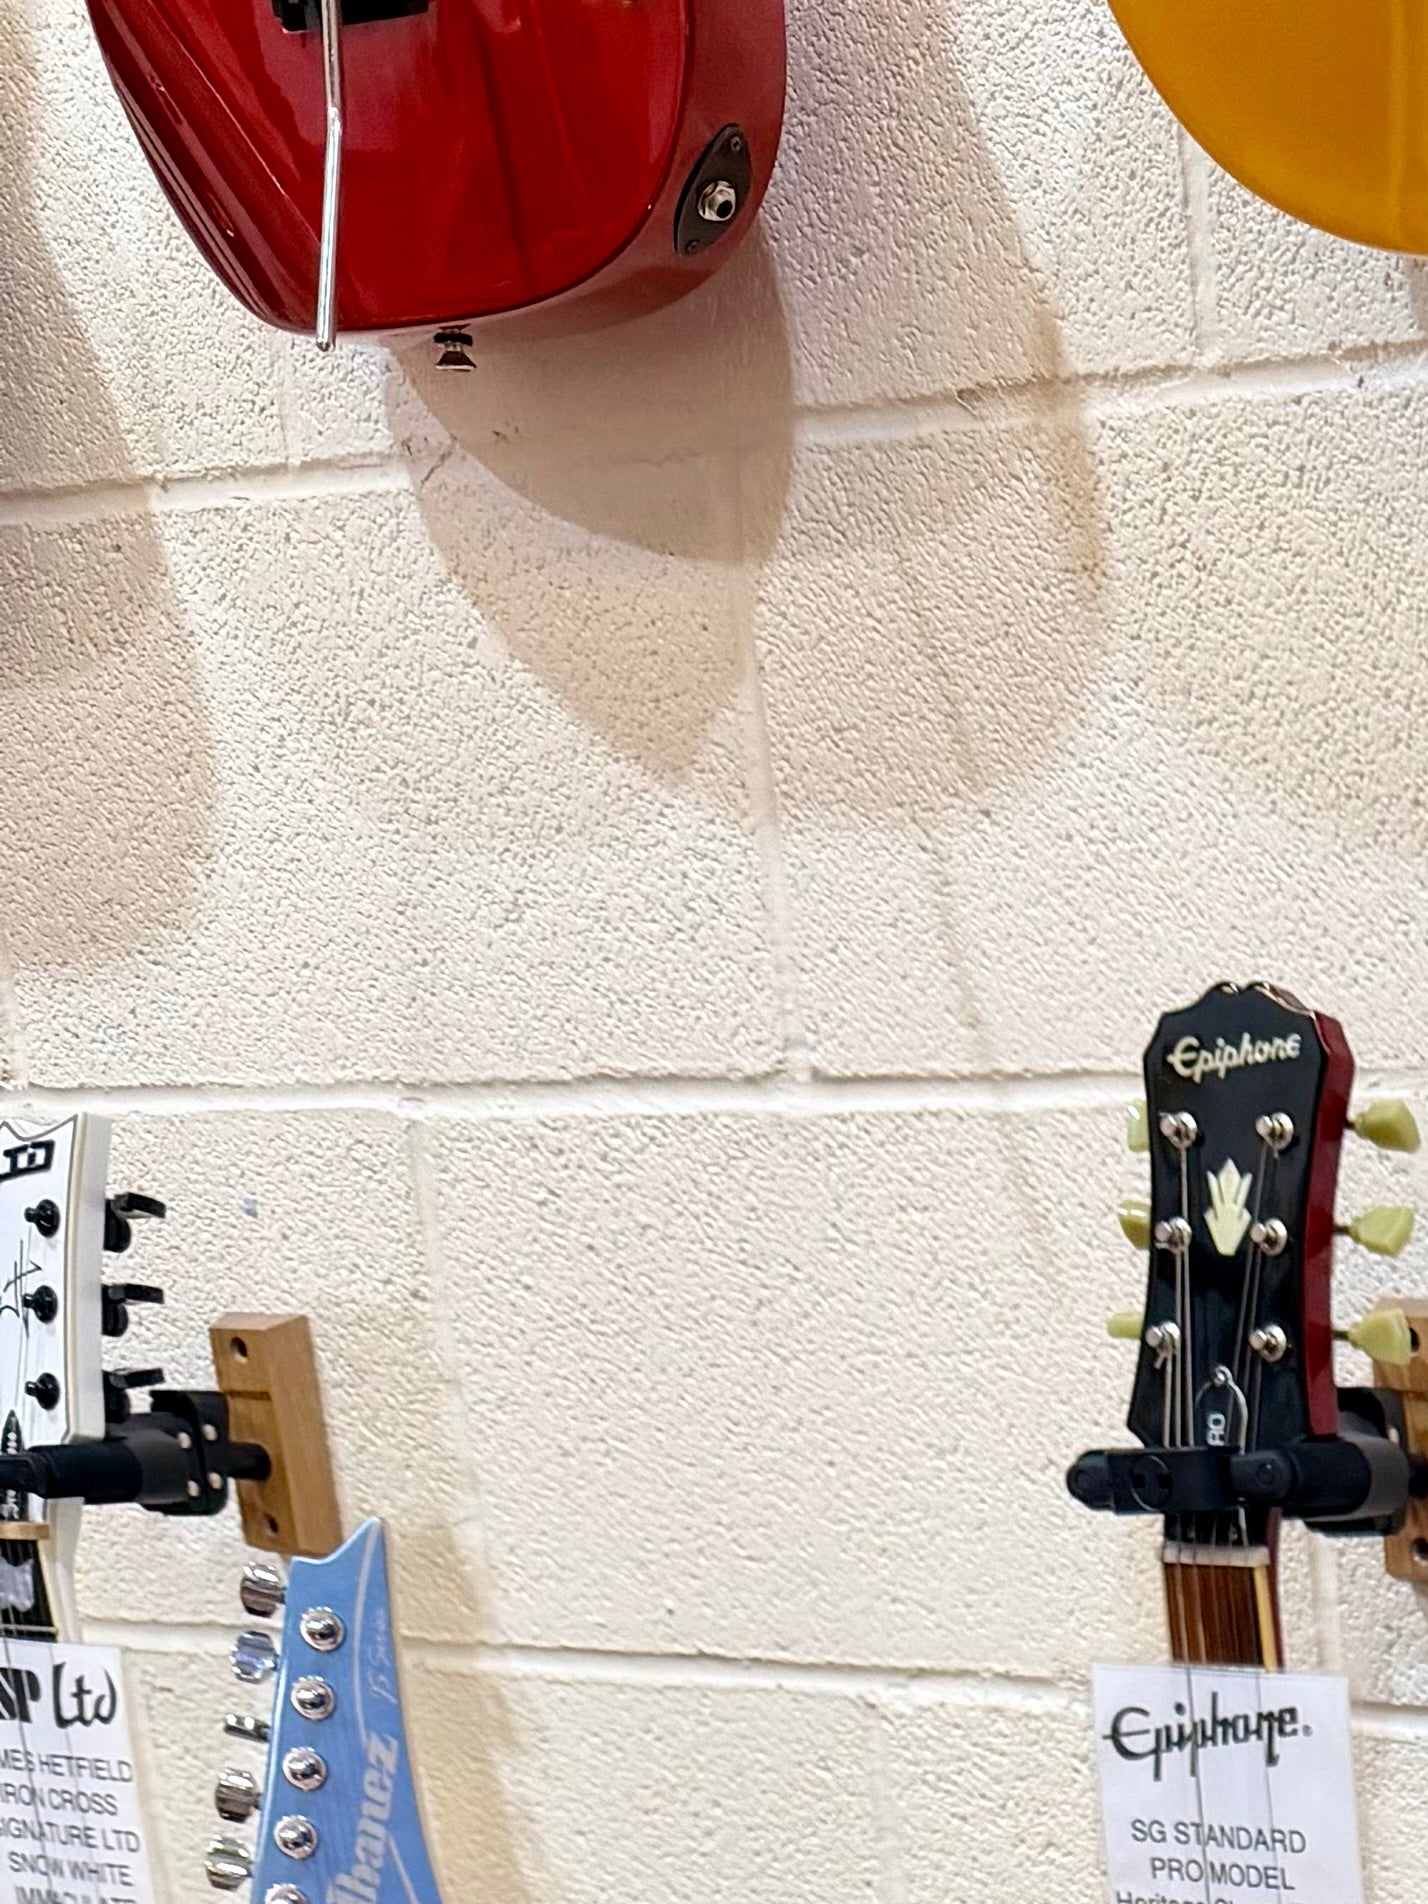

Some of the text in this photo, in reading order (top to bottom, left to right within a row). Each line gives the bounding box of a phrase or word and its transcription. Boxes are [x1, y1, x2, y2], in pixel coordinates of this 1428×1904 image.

[1166, 1032, 1302, 1085] Epiphone
[1206, 1413, 1226, 1447] RO
[1103, 1691, 1299, 1782] Epiphone
[0, 1749, 133, 1783] MES HETFIELD
[48, 1788, 118, 1817] CROSS
[103, 1829, 141, 1853] LTD
[1131, 1819, 1307, 1855] SG STANDARD
[8, 1851, 135, 1888] SNOW WHITE
[1150, 1858, 1296, 1892] PRO MODEL
